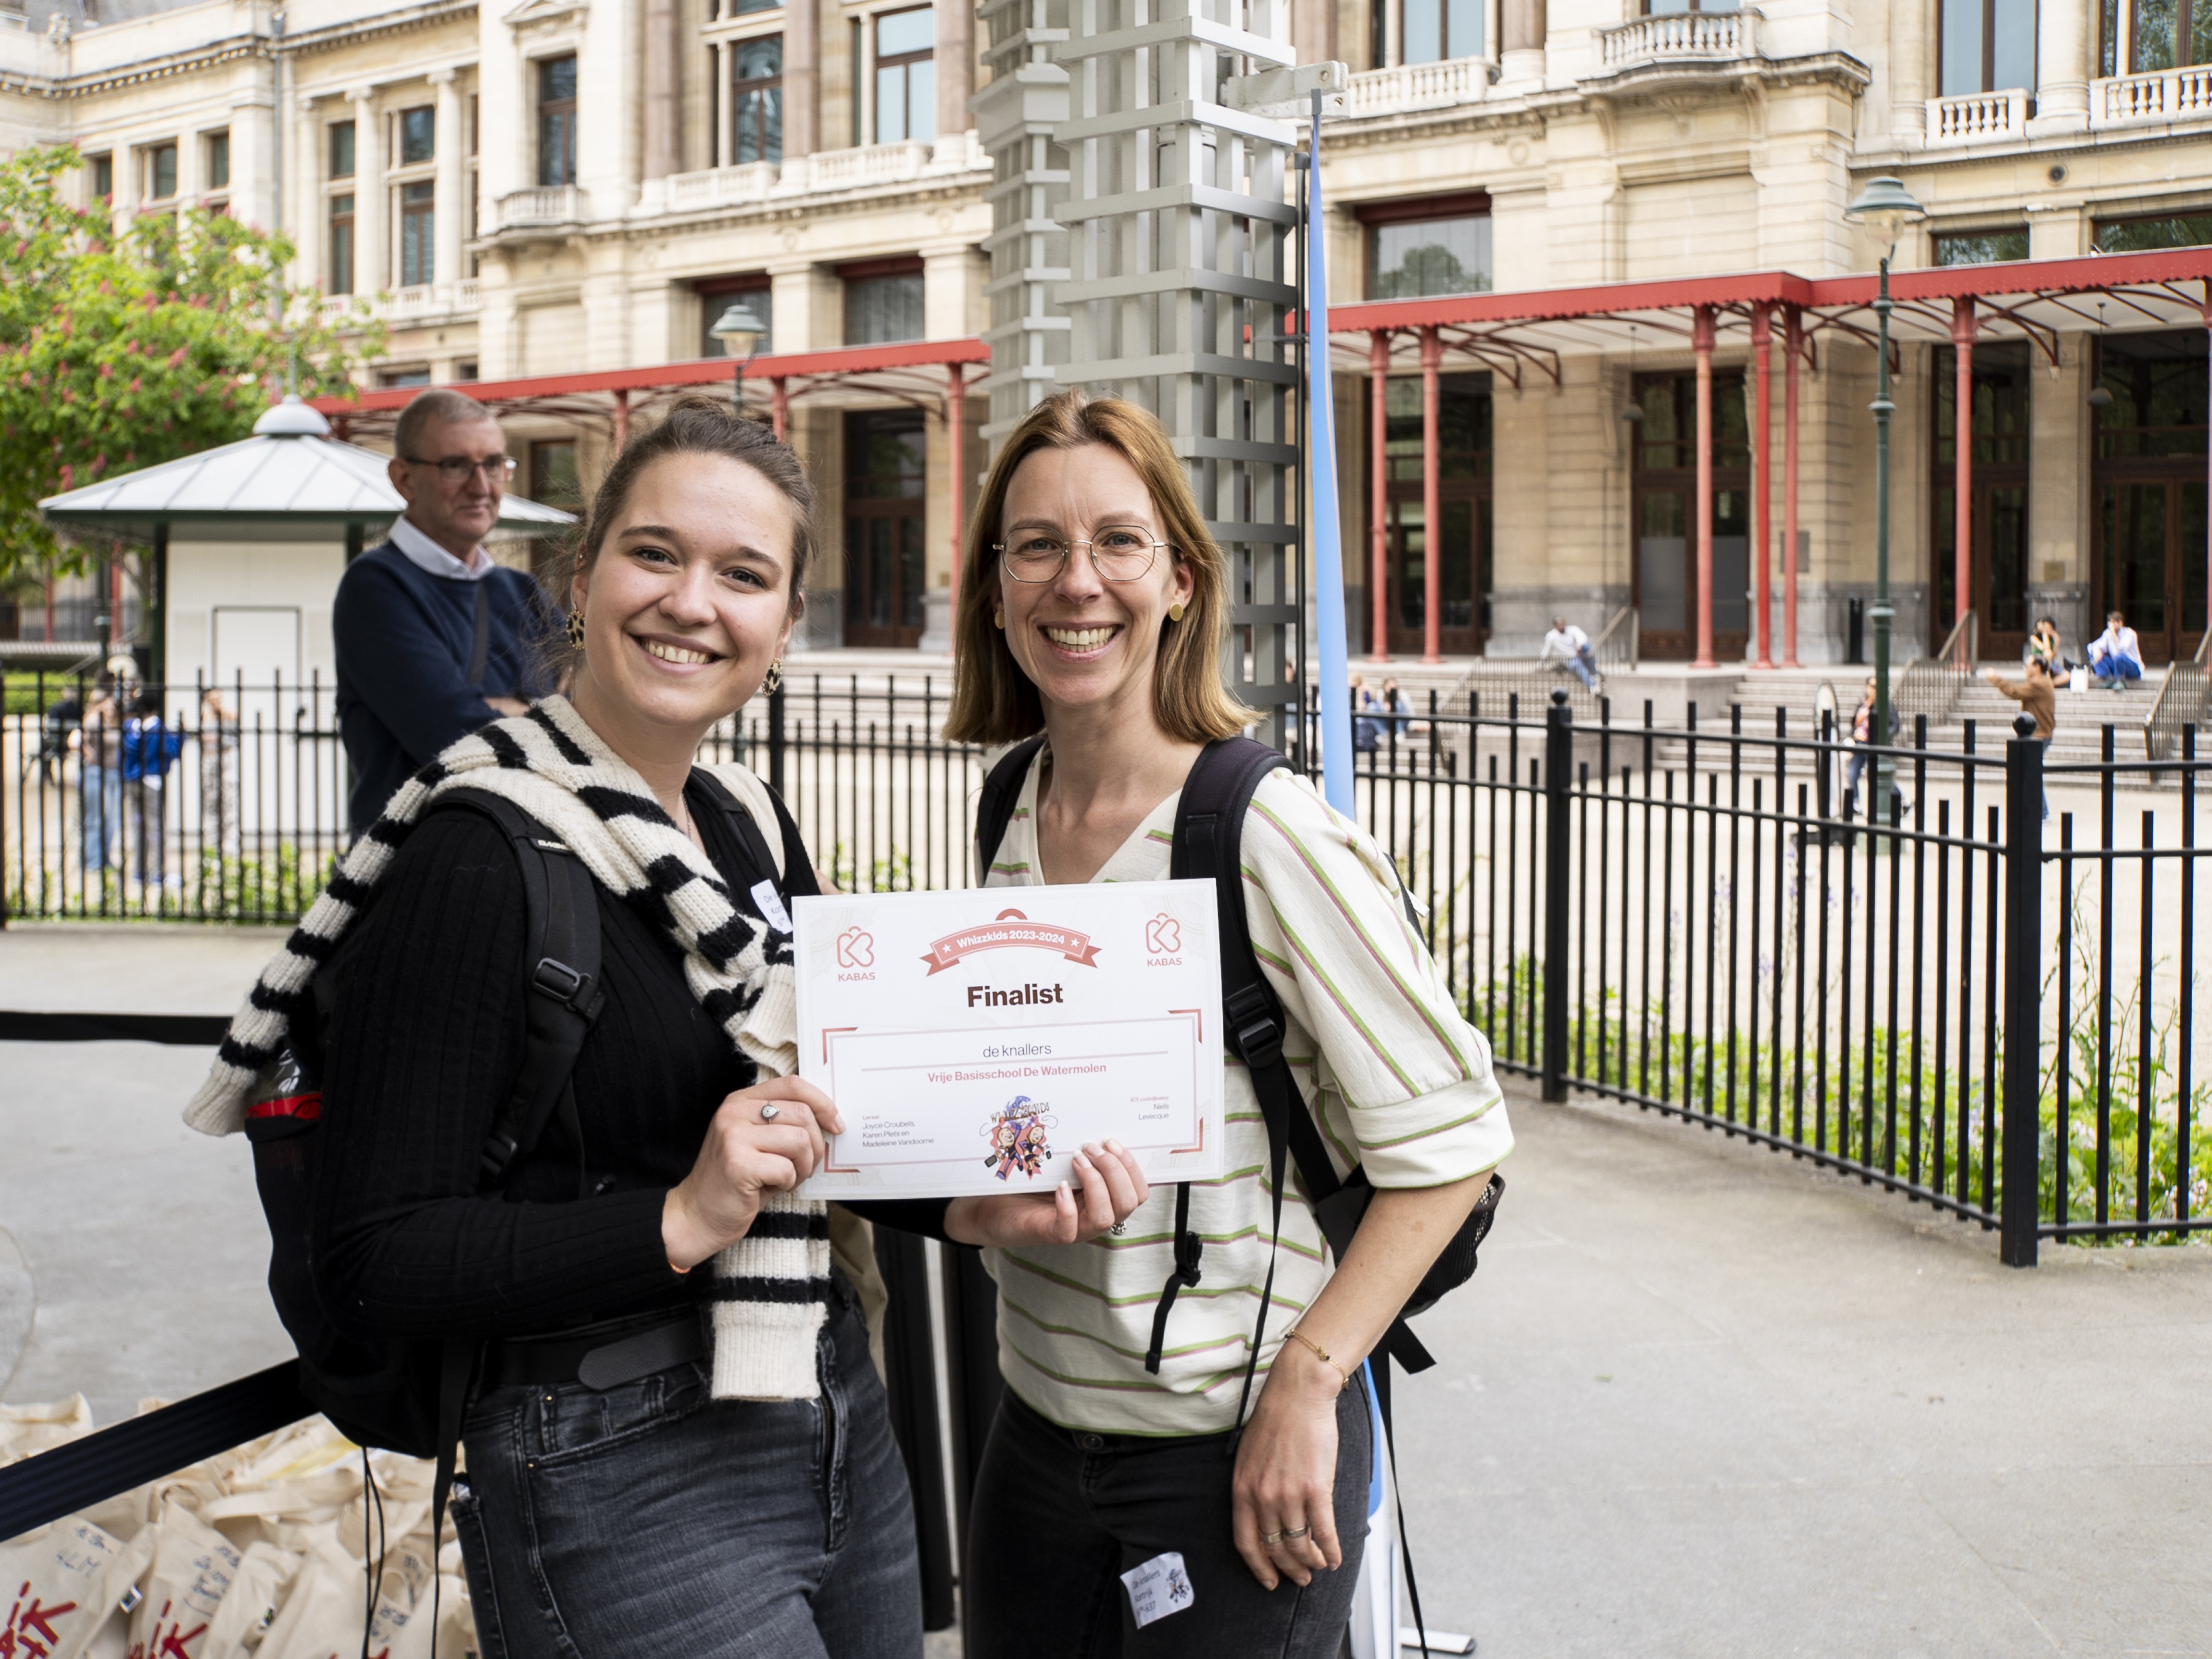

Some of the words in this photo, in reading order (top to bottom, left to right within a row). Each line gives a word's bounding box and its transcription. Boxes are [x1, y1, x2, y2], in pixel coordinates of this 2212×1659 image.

[956, 930, 1008, 948] Whizzkids
[1009, 930, 1065, 944] 2023-2024
[1147, 957, 1182, 967] KABAS
[838, 972, 875, 981] KABAS
[968, 983, 1063, 1007] Finalist
[983, 1046, 999, 1057] de
[1002, 1044, 1052, 1056] knallers
[928, 1073, 952, 1083] Vrije
[955, 1068, 1021, 1081] Basisschool
[1024, 1068, 1038, 1077] De
[1041, 1063, 1106, 1076] Watermolen
